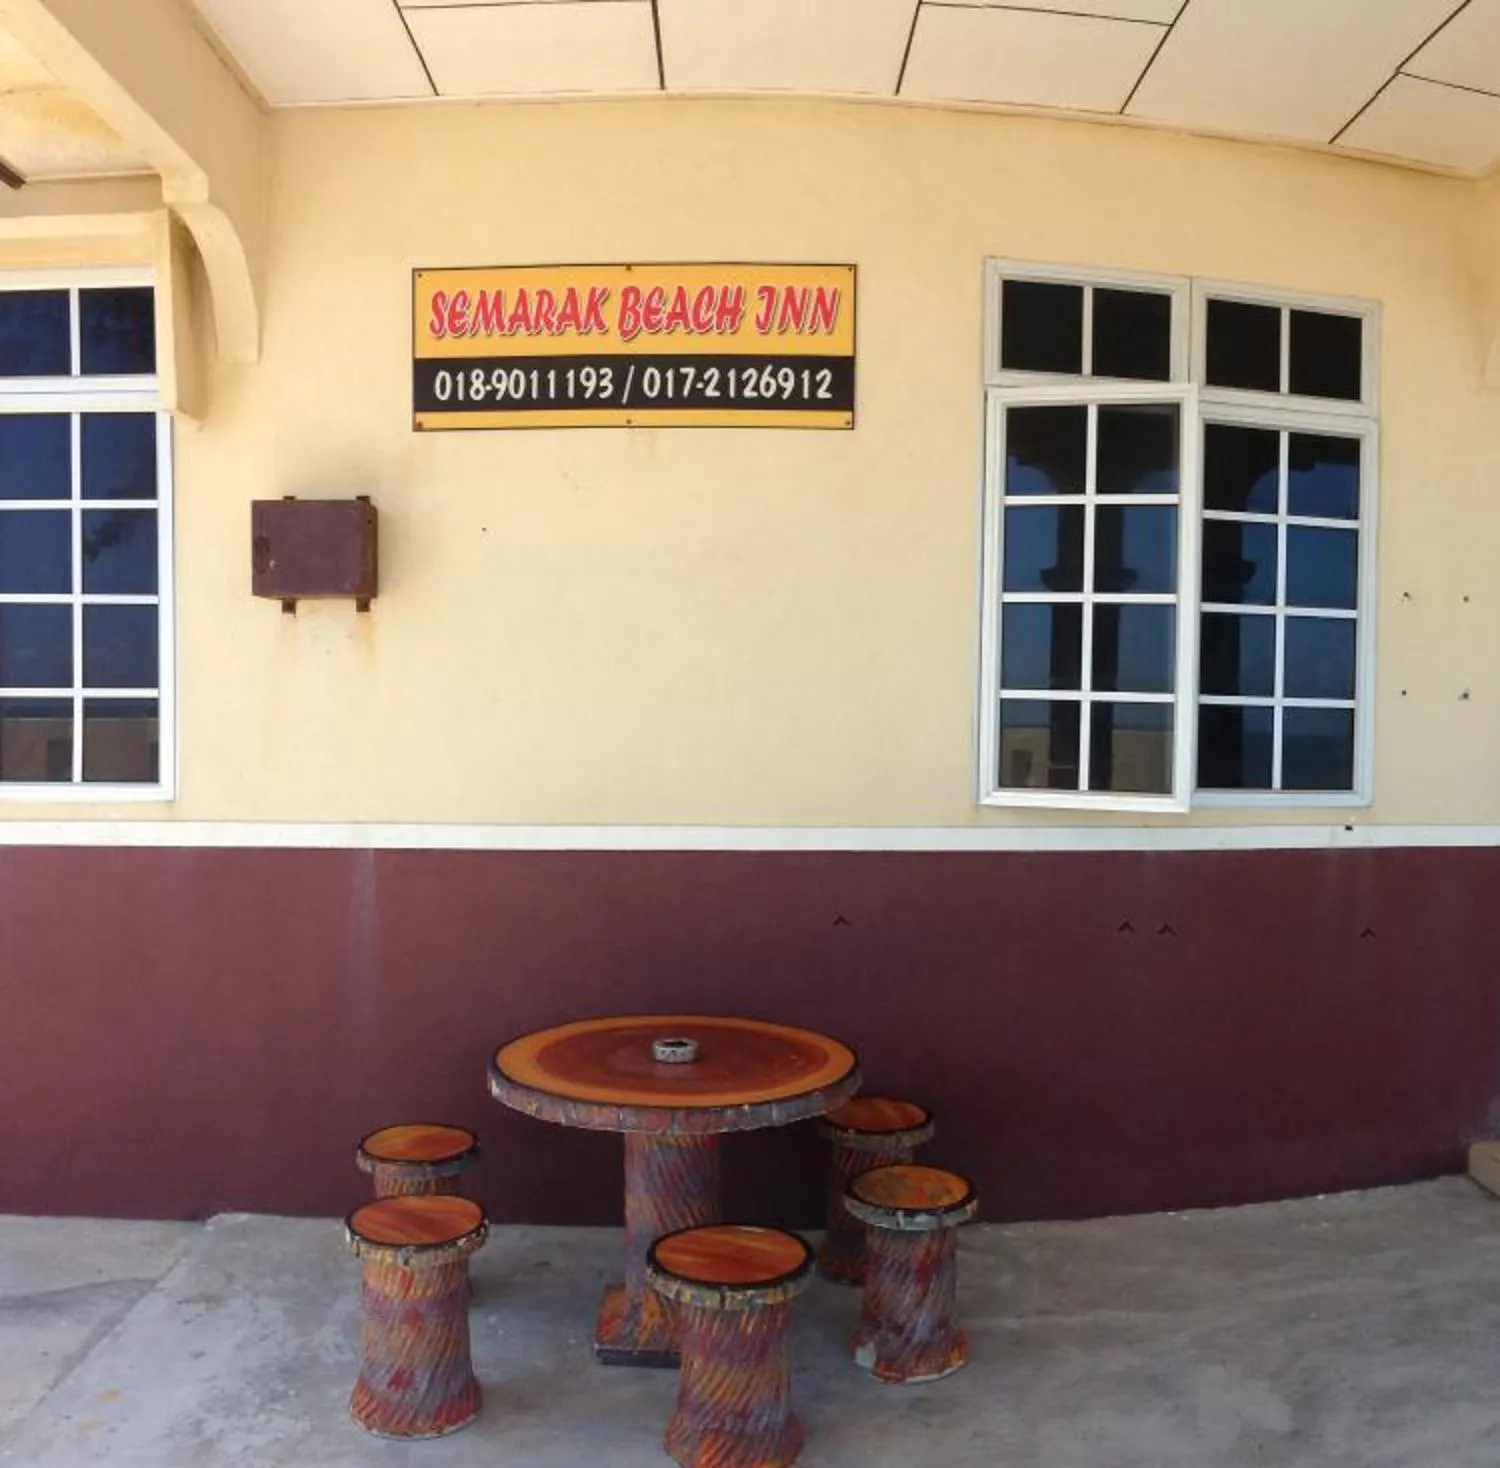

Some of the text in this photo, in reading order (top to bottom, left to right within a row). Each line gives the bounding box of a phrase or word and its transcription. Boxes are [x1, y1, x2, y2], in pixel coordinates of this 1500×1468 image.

[429, 284, 840, 341] SEMARAK BEACH INN
[434, 366, 614, 401] 018-9011193
[642, 364, 833, 400] 017-2126912
